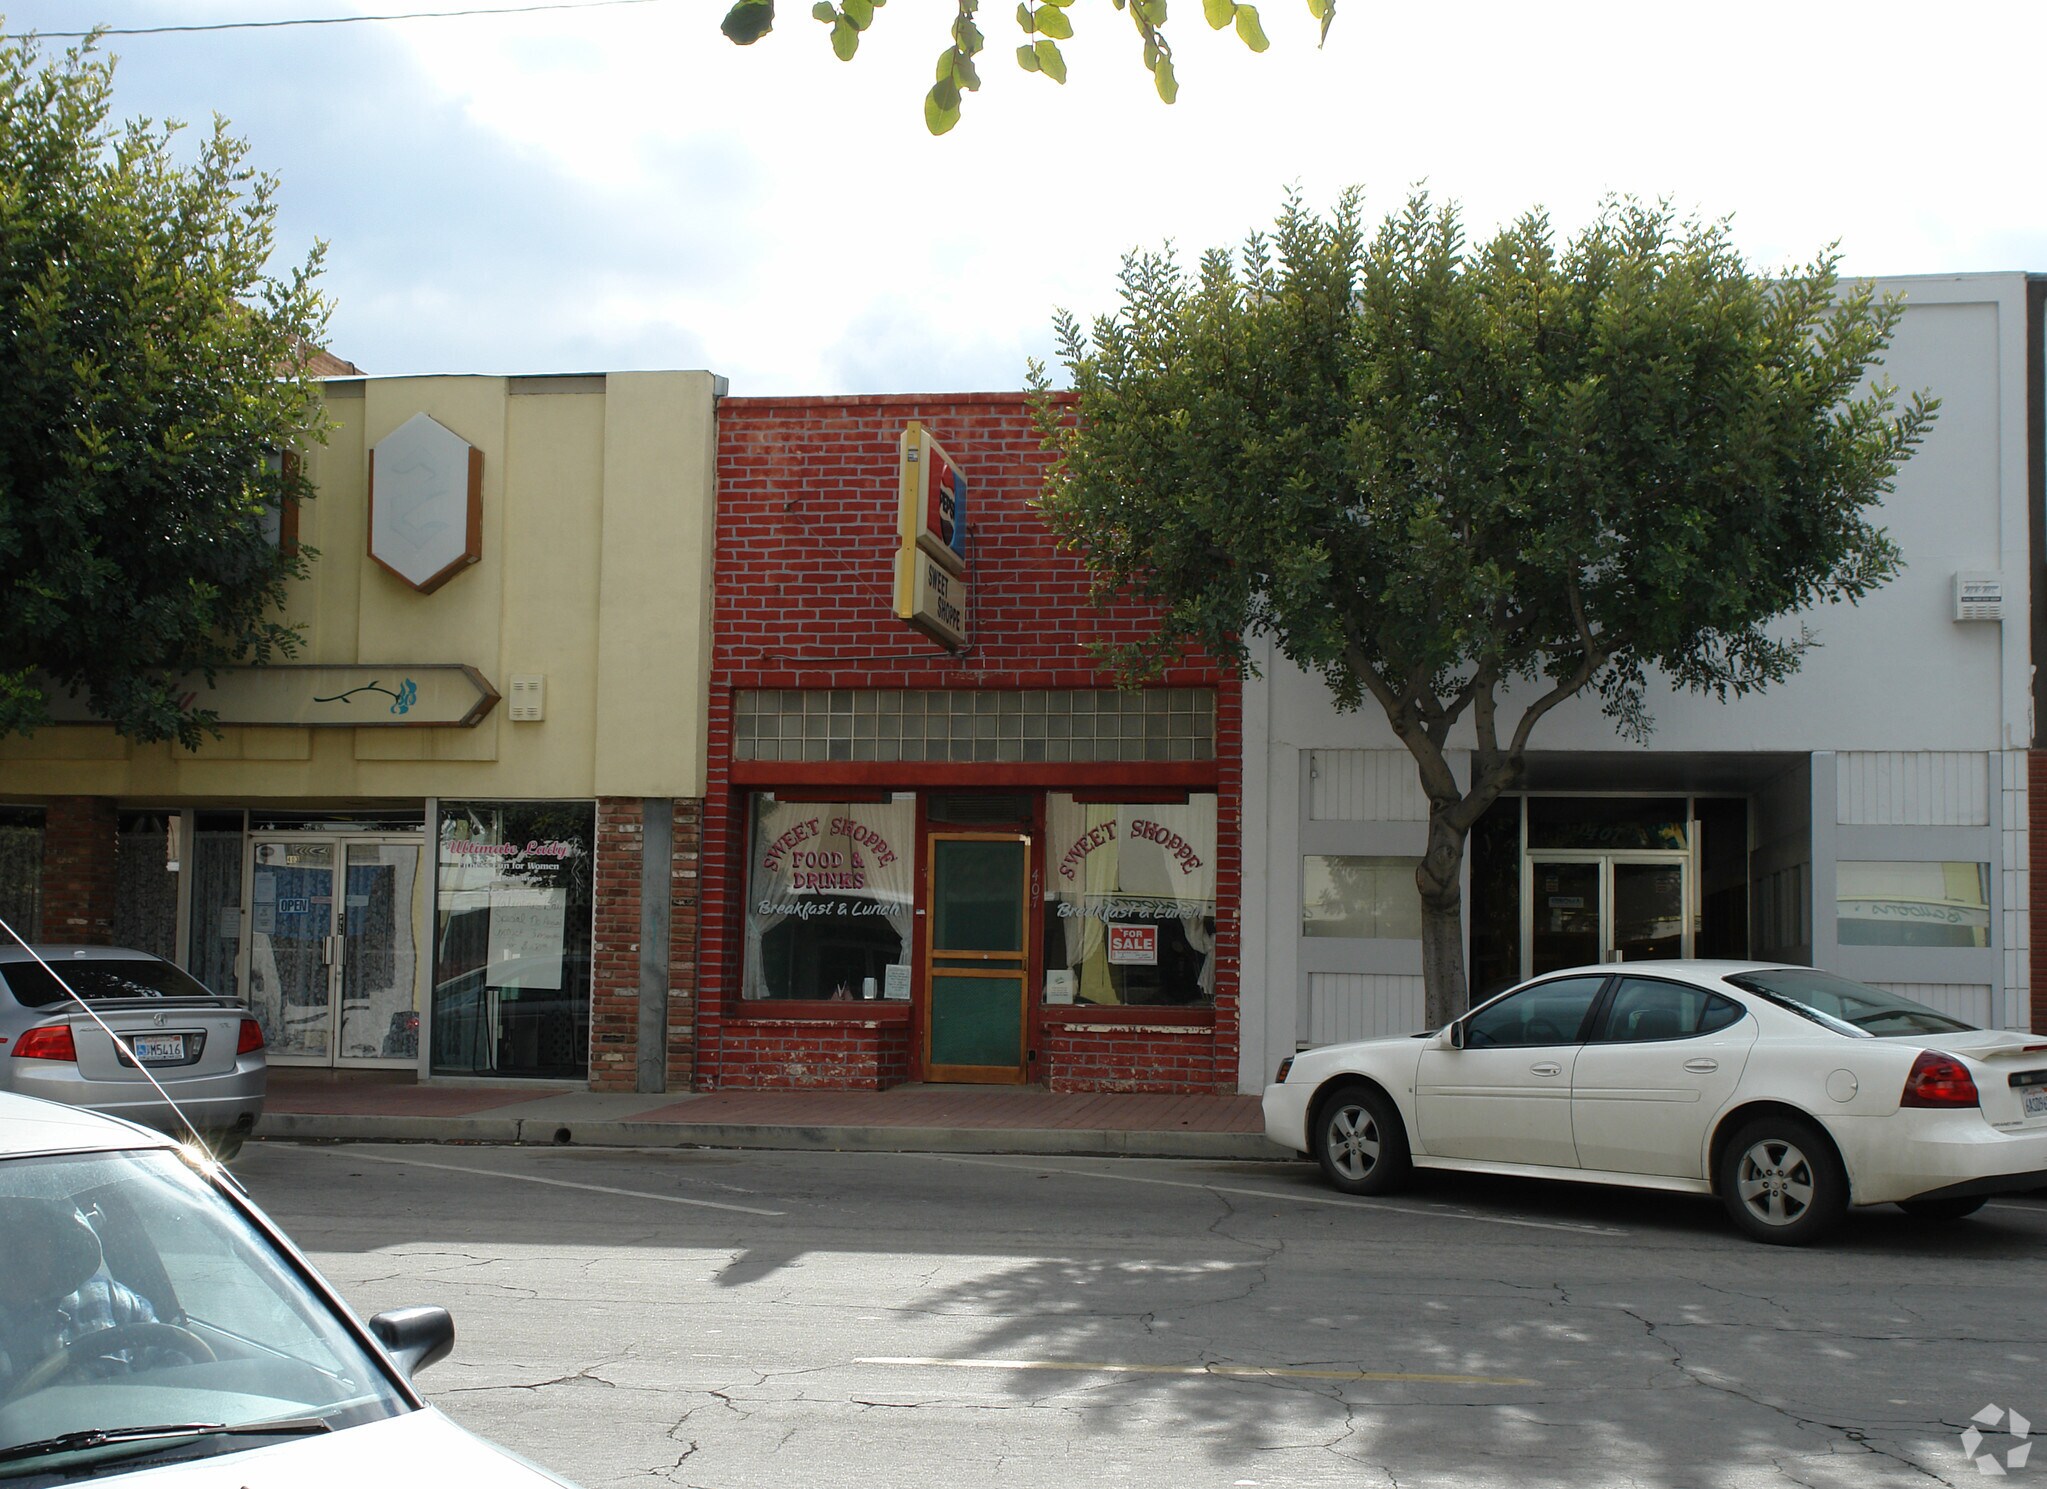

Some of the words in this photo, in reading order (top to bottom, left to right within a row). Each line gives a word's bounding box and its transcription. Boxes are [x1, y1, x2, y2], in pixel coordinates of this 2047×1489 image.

[928, 564, 948, 599] SWEET
[937, 596, 960, 632] SHOPPE
[447, 840, 518, 855] Ultimate
[524, 840, 567, 860] Lady
[763, 817, 820, 872] SWEET
[829, 817, 898, 869] SHOPPE
[1059, 820, 1117, 881] SWEET
[1130, 819, 1203, 875] SHOPPE
[528, 862, 559, 870] Women
[792, 851, 844, 869] FOOD
[851, 851, 865, 869] &
[793, 872, 865, 895] DRINKS
[281, 899, 307, 912] OPEN
[758, 900, 834, 920] Breakfast
[837, 903, 847, 915] &
[852, 901, 900, 916] Lunch
[1057, 902, 1133, 922] Breakfast
[1112, 937, 1153, 950] SALE
[1123, 930, 1143, 938] FOR
